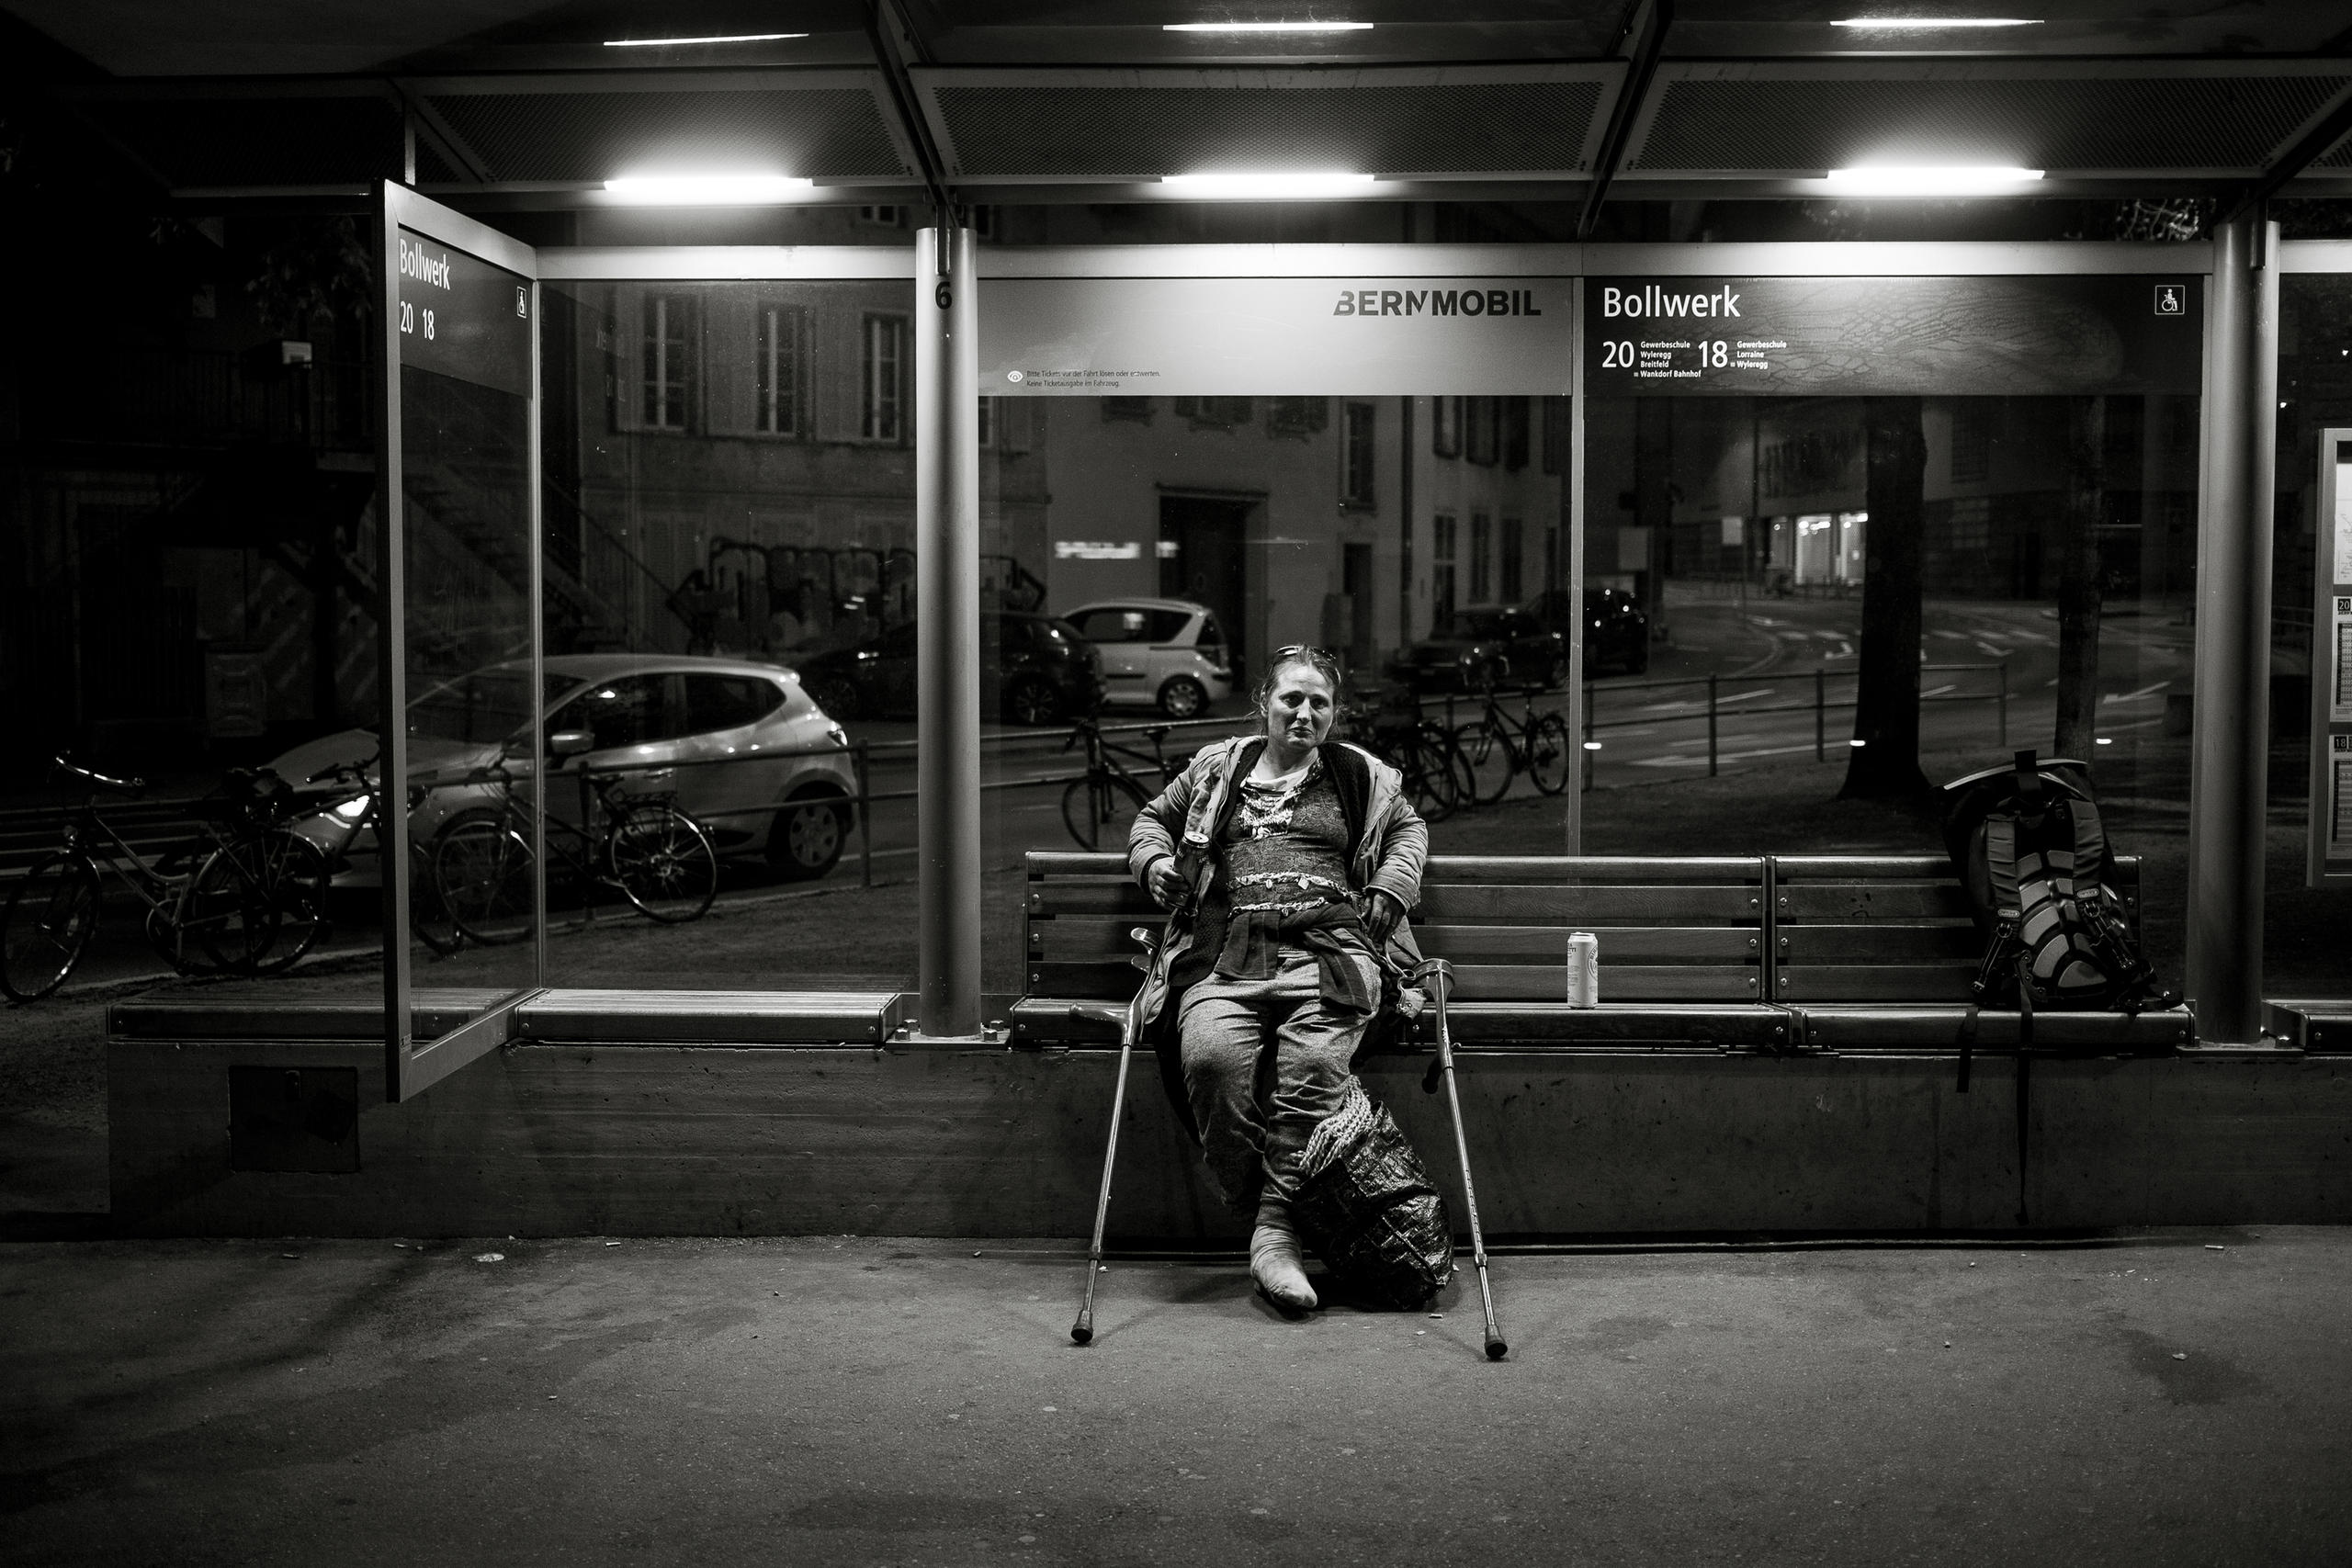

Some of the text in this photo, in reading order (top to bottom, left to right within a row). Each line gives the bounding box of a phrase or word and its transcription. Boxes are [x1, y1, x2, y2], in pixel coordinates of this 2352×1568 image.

[400, 239, 450, 290] Bollwerk
[935, 281, 952, 310] 6
[1604, 285, 1741, 317] Bollwerk
[400, 300, 435, 341] 20 18
[1640, 341, 1691, 349] Gewerbeschule
[1736, 340, 1788, 349] Gewerbeschule
[1602, 341, 1634, 368] 20
[1640, 350, 1672, 360] Wyleregg
[1698, 340, 1728, 368] 18
[1736, 350, 1765, 359] Lorraine
[1640, 360, 1669, 368] Breitfeld
[1736, 360, 1769, 369] Wyleregg
[1083, 369, 1098, 378] Fahrt
[1099, 369, 1114, 378] lösen
[1115, 369, 1129, 378] oder
[1640, 369, 1702, 378] Wankdorf Bahnhof
[1044, 379, 1084, 389] Ticketausgabe
[2338, 600, 2350, 610] 20
[2335, 738, 2346, 748] 18
